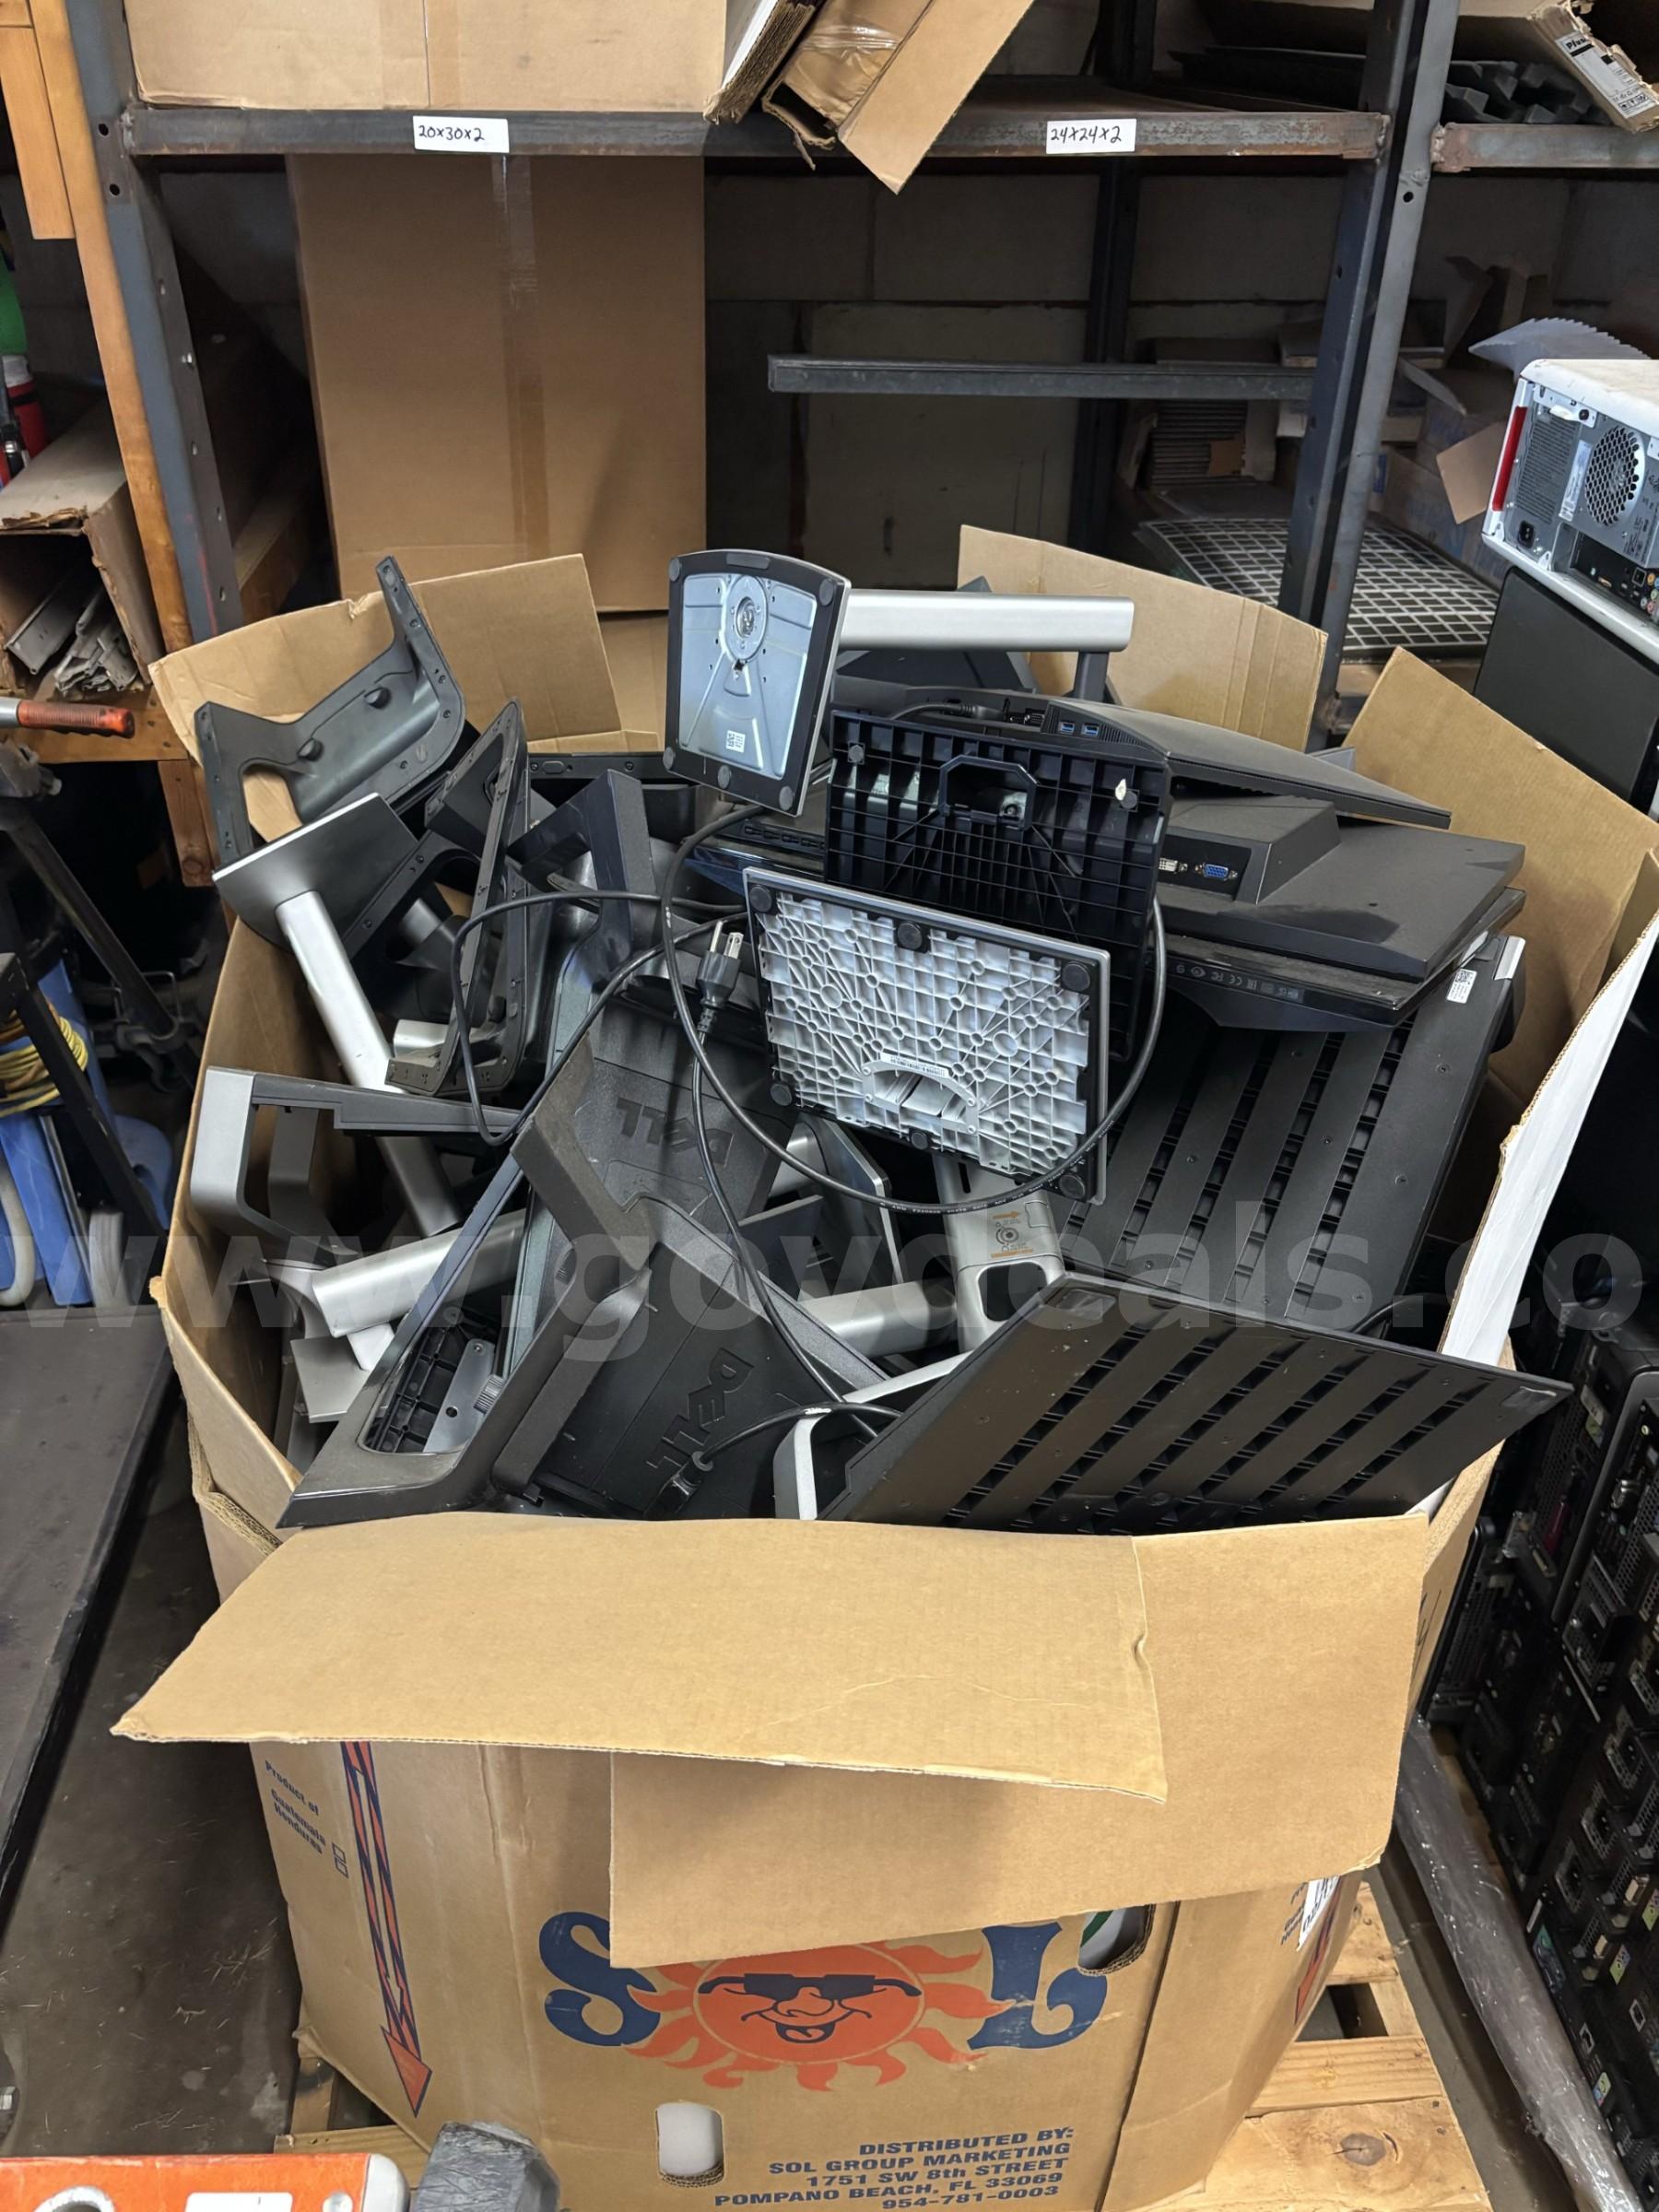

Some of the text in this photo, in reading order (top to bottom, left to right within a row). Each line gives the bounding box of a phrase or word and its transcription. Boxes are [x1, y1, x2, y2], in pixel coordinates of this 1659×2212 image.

[617, 1097, 735, 1169] DELL
[646, 1347, 756, 1469] DELL
[265, 1759, 320, 1817] Product of
[271, 1788, 326, 1847] Guatemala
[769, 2142, 1071, 2174] SOL GROUP MARKETING
[859, 2126, 1075, 2156] DISTRIBUTED BY:
[714, 2172, 1063, 2206] POMPANO BEACH, FL 33069
[806, 2158, 1069, 2187] 1751 SW 8th STREET
[881, 2185, 1059, 2209] 954-781-0003
